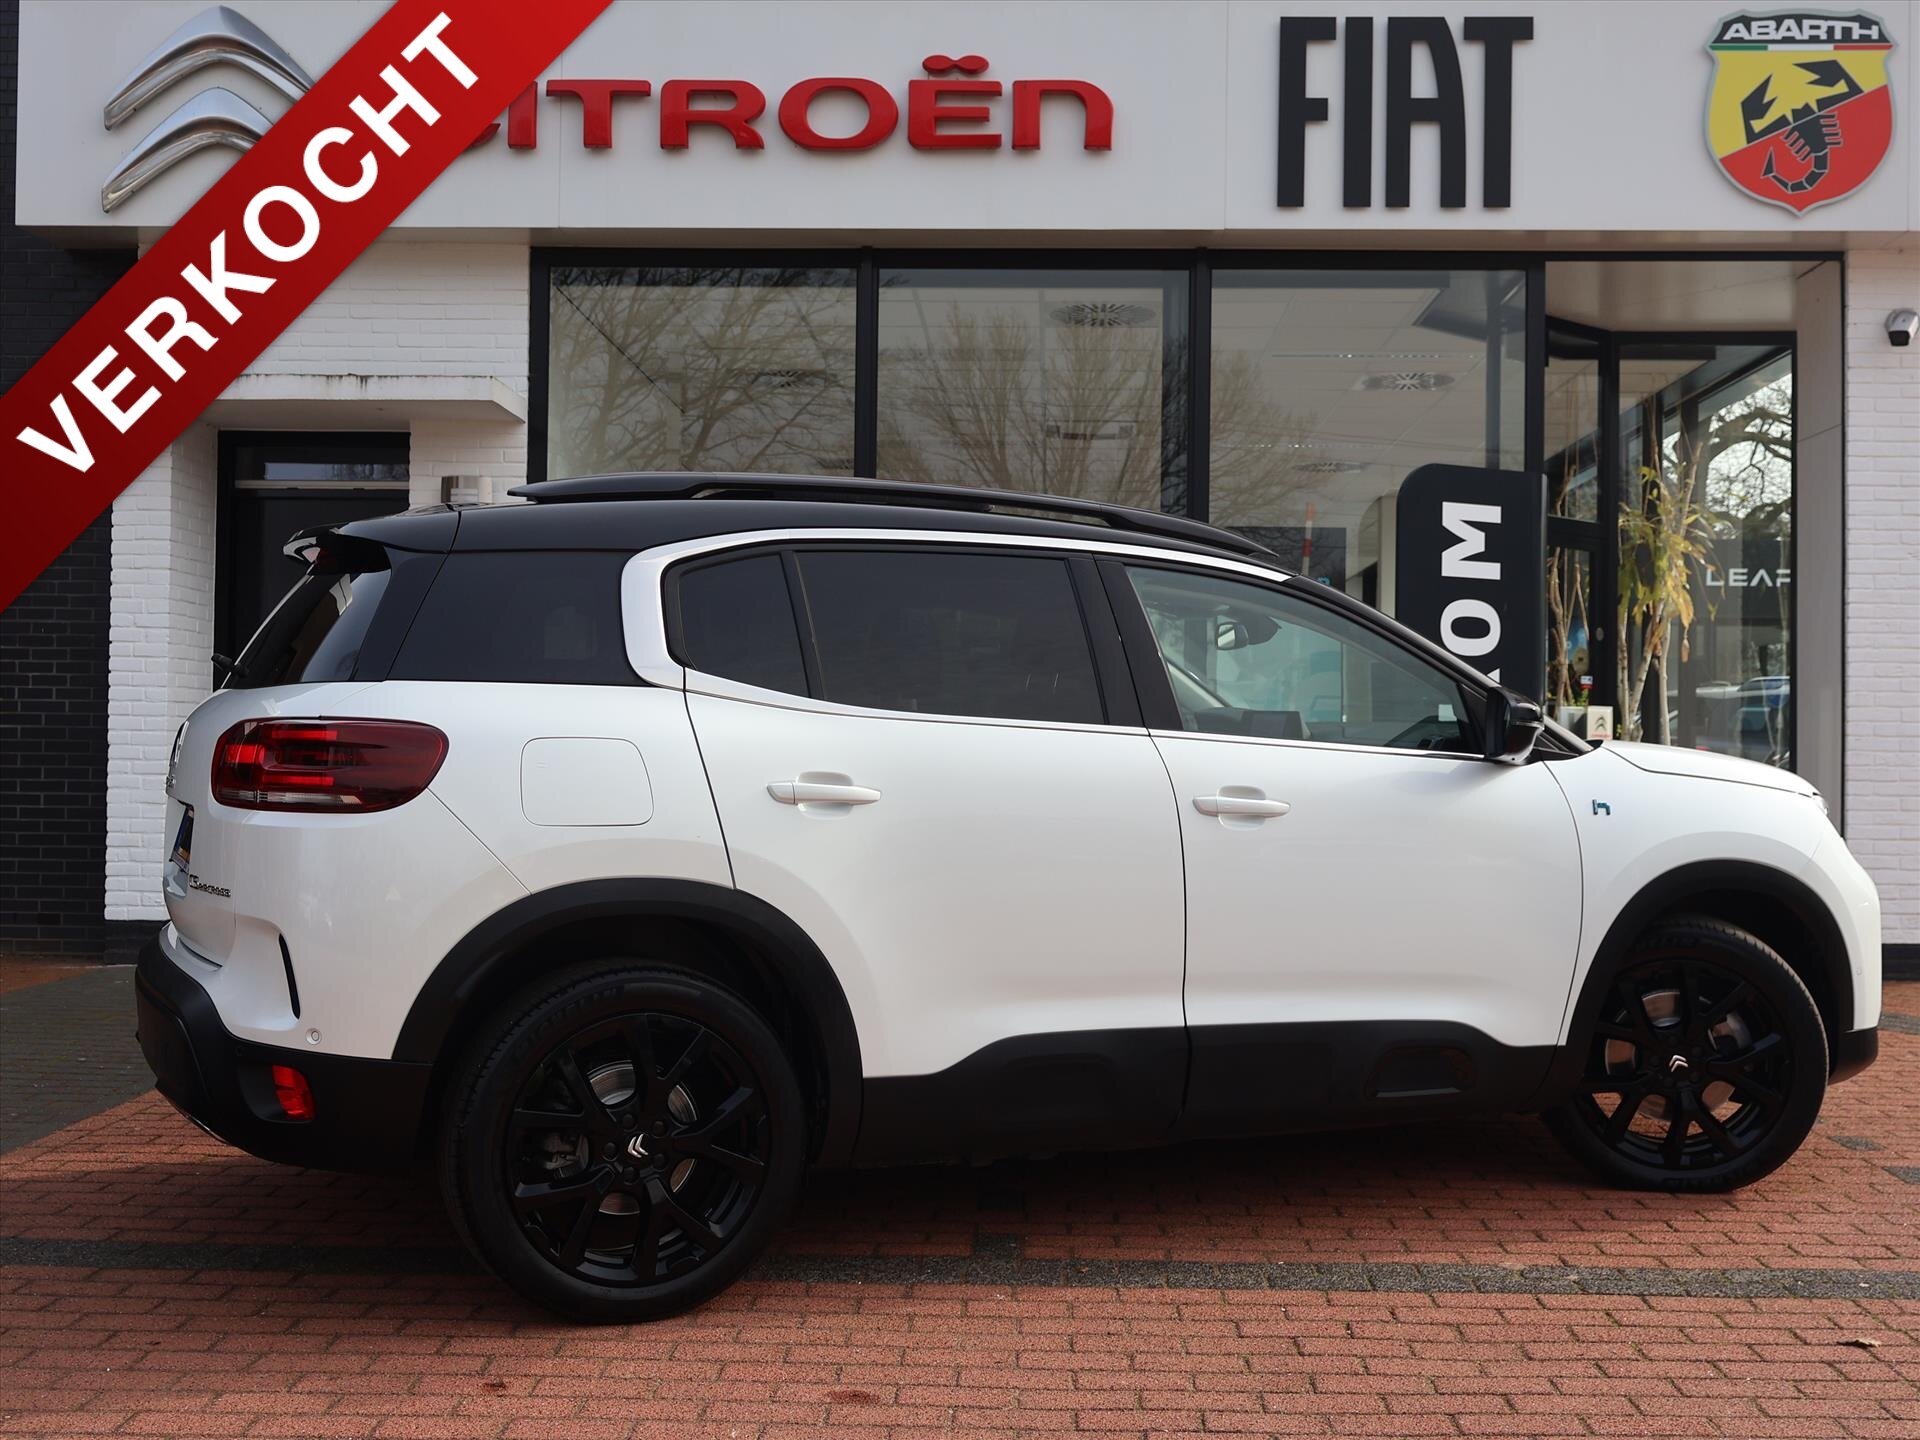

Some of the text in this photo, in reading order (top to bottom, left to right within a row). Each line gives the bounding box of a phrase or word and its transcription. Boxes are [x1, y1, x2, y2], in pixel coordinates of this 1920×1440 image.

[1722, 18, 1880, 41] ABARTH
[462, 54, 1114, 152] ITROËN
[1277, 16, 1534, 209] FIAT
[1440, 501, 1502, 684] OM
